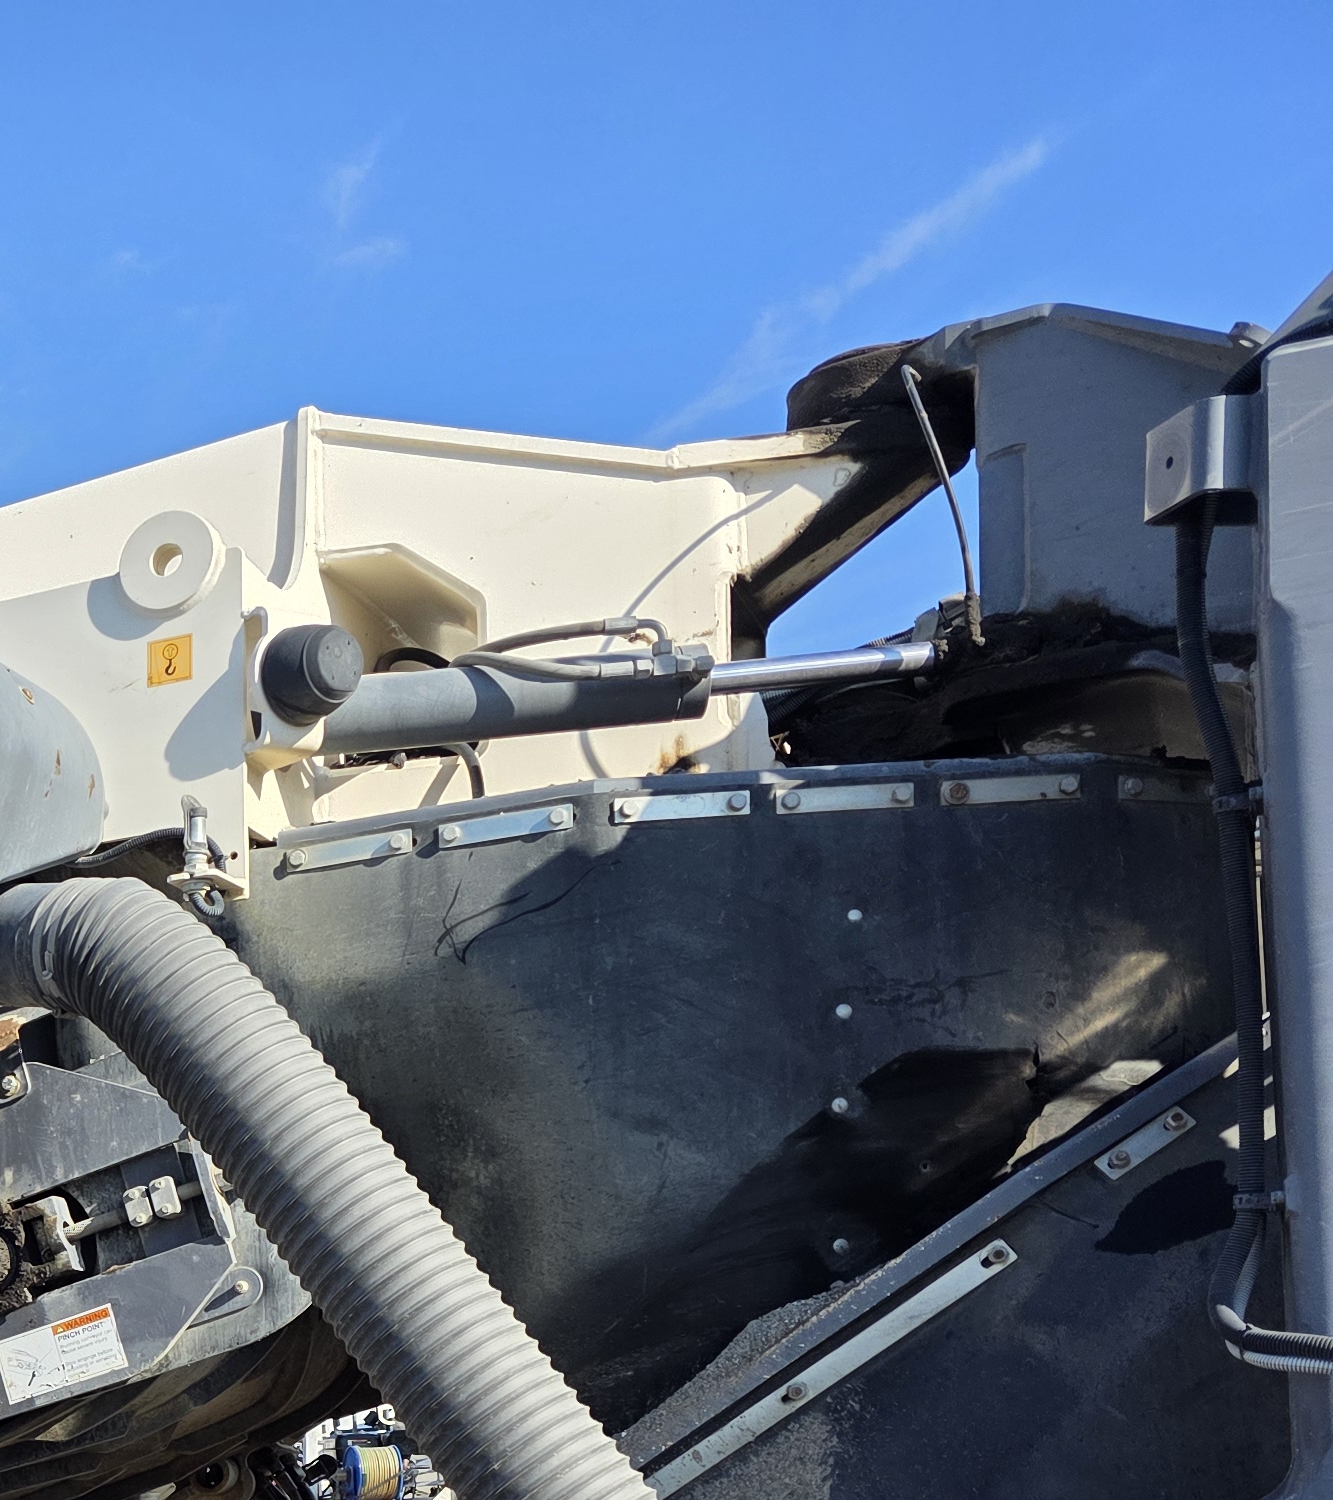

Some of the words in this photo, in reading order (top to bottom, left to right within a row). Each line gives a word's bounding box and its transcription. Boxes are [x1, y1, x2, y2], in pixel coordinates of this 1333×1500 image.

[64, 1309, 108, 1330] WARNING
[58, 1329, 81, 1342] PINCH
[82, 1321, 104, 1335] POINT
